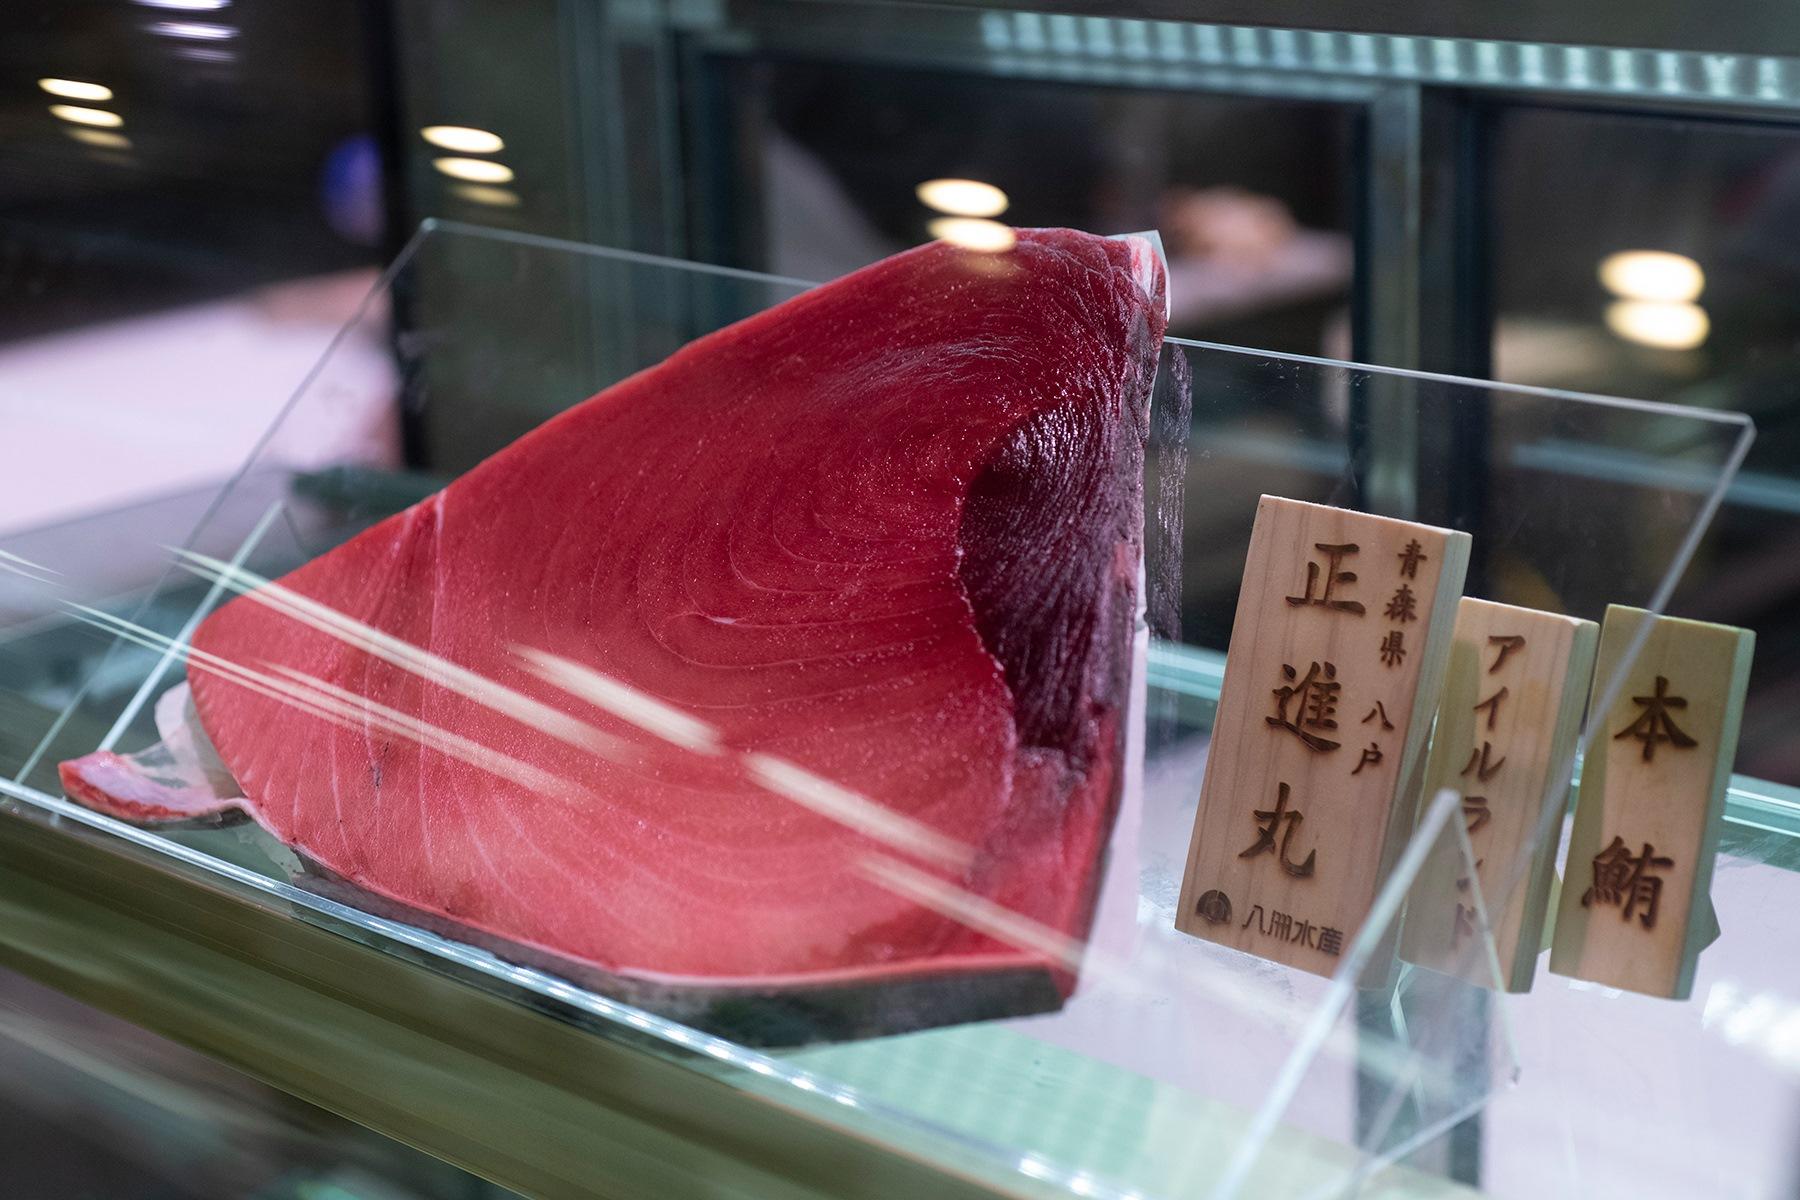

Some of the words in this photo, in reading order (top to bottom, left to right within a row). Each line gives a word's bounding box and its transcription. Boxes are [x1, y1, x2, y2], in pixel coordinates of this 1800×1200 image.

[1379, 538, 1428, 669] 青森県
[1238, 542, 1367, 879] 正進丸
[1351, 700, 1395, 776] 八戸
[1581, 675, 1698, 930] 本鮪
